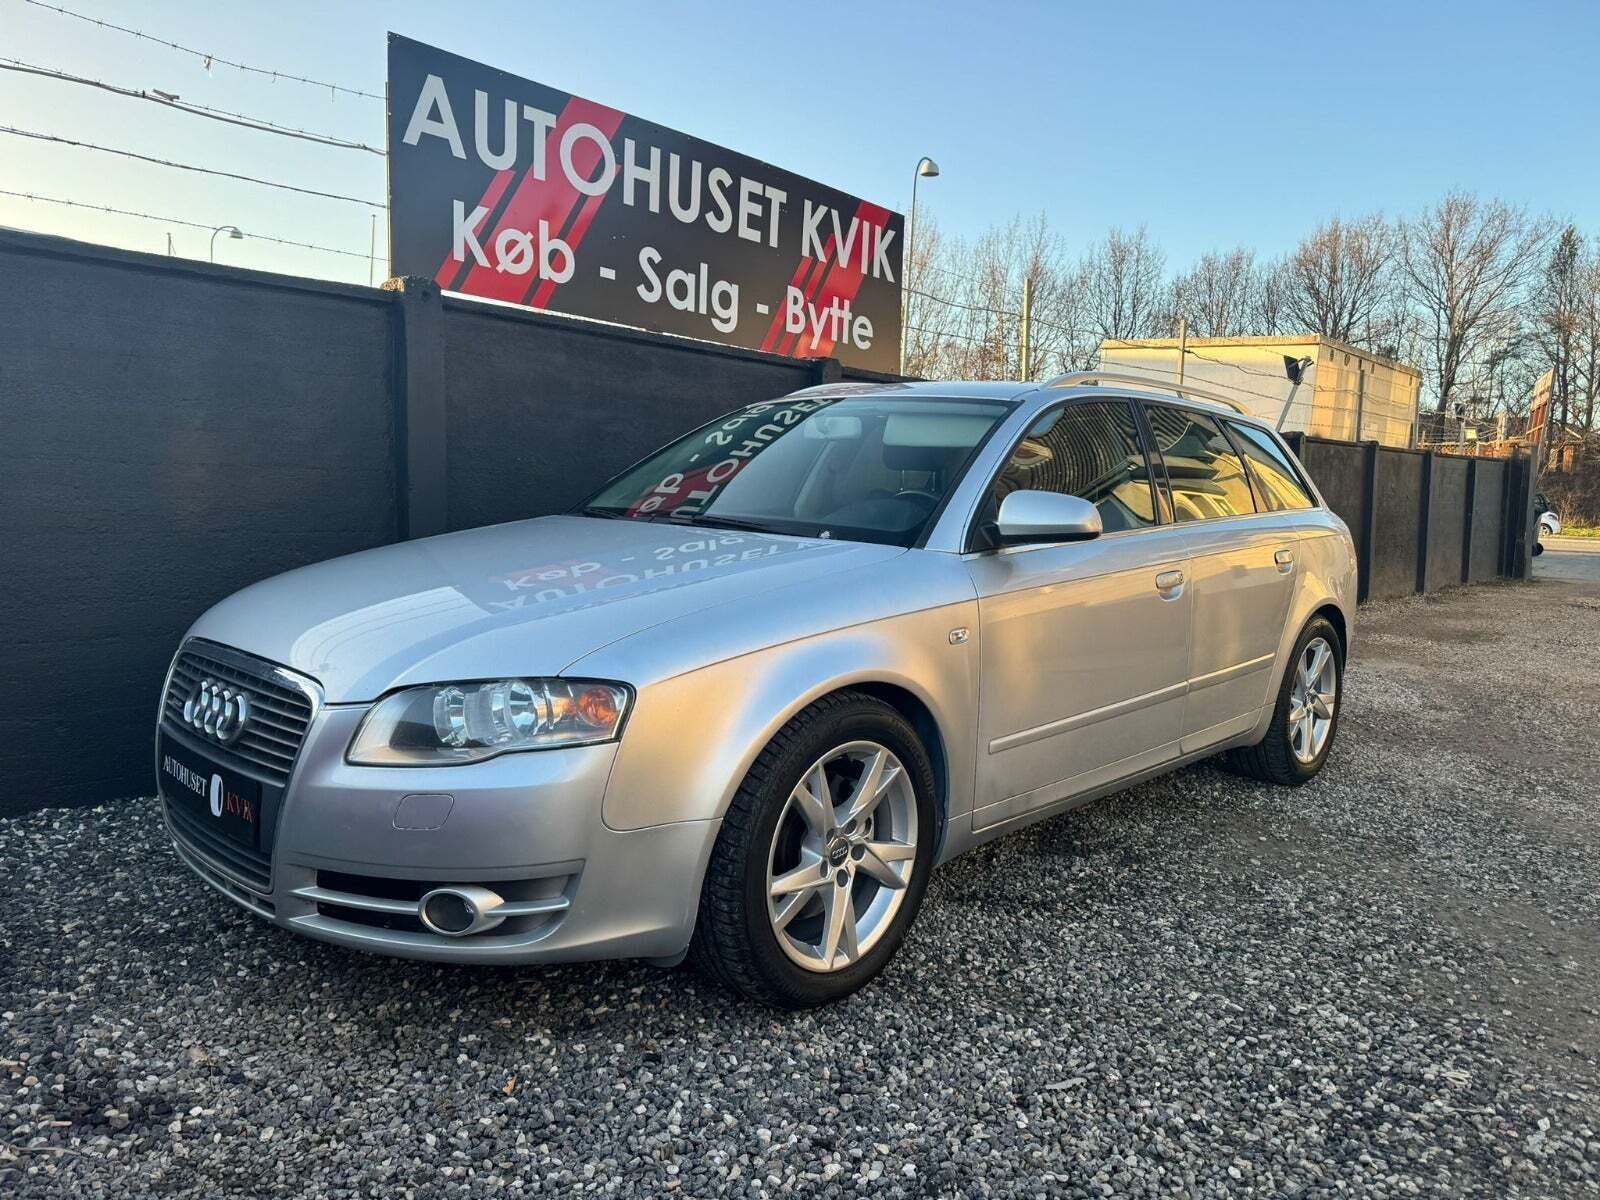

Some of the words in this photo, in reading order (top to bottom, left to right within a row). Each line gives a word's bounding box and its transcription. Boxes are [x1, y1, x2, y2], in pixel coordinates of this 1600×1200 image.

[403, 74, 787, 248] AUTOHUSET
[801, 199, 896, 283] KVIK
[453, 200, 575, 284] Køb
[636, 246, 740, 333] Salg
[785, 285, 874, 350] Bytte
[163, 754, 207, 798] AUTOHUSET
